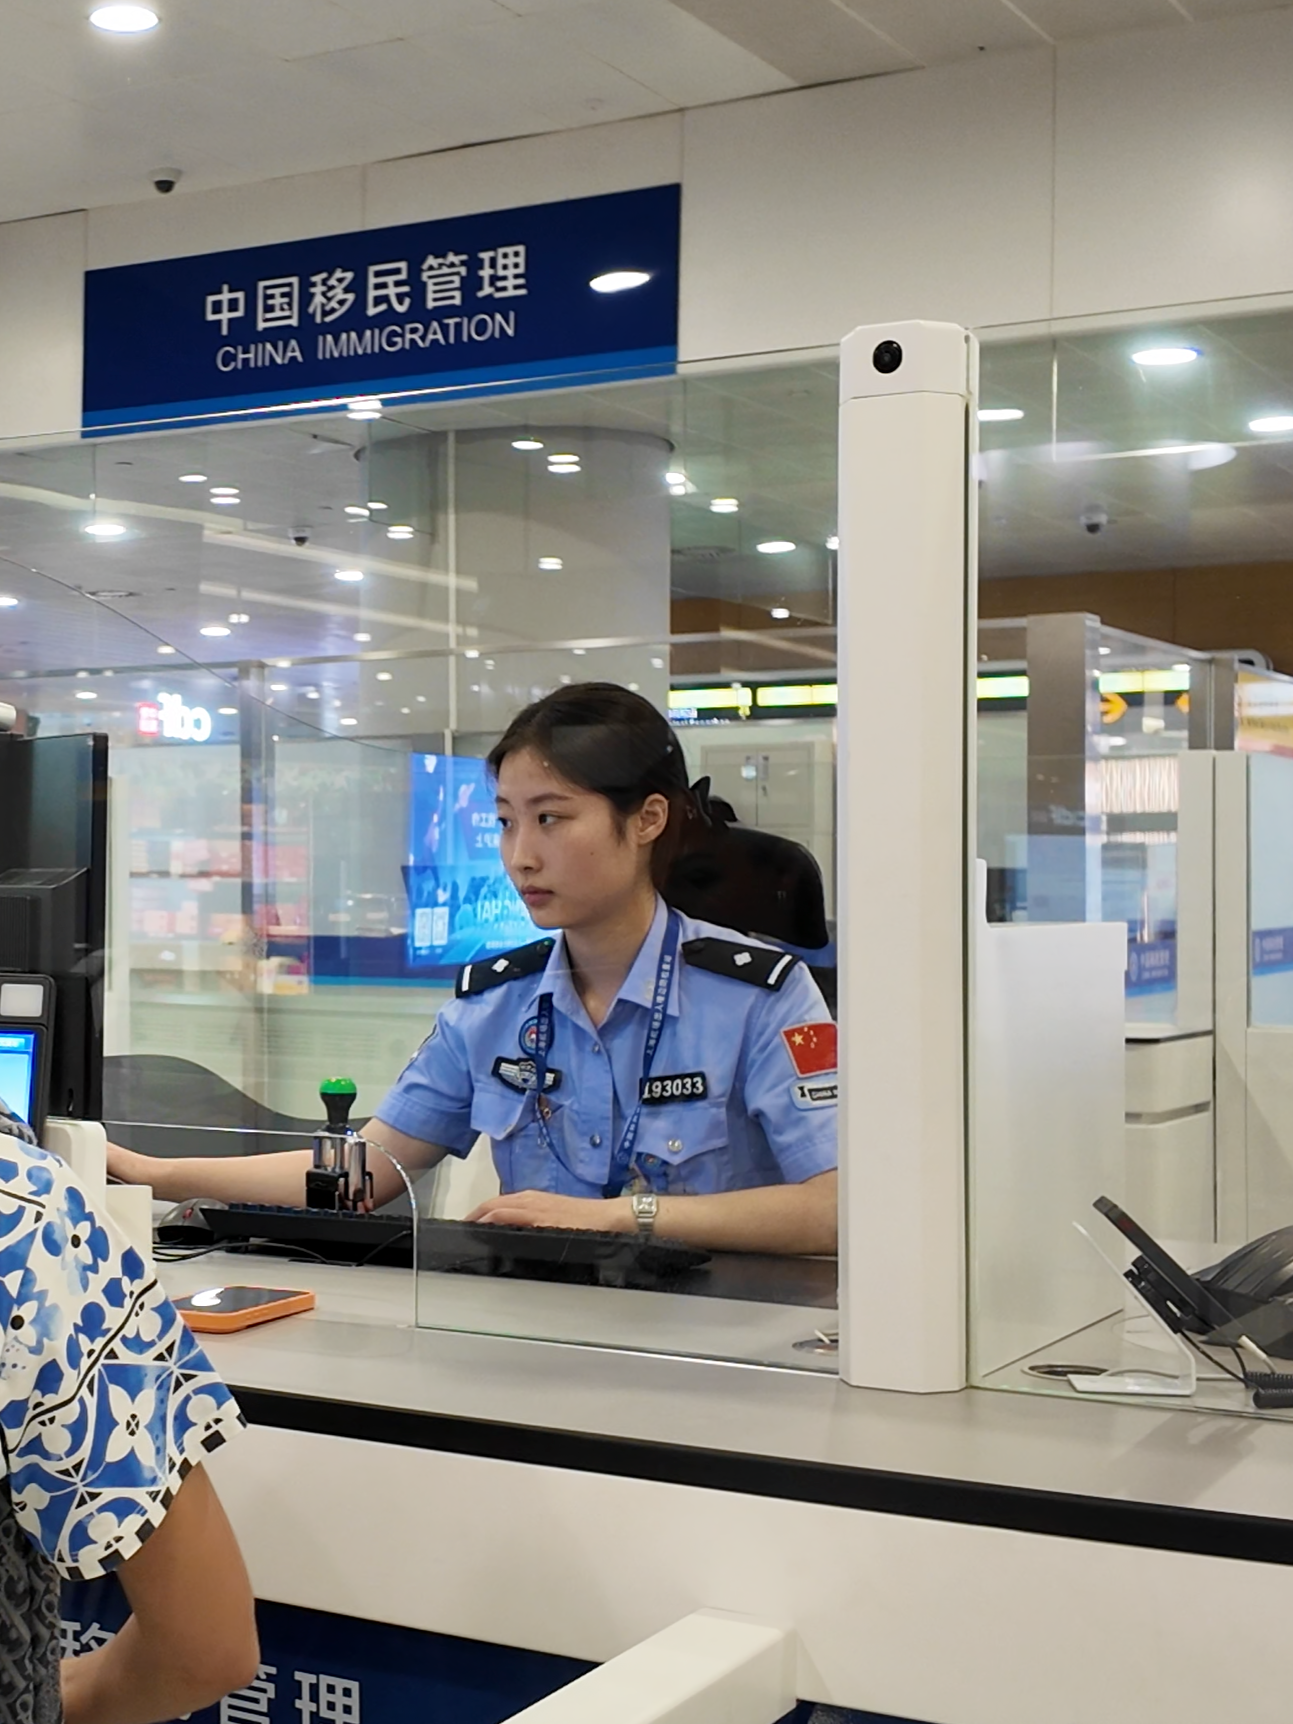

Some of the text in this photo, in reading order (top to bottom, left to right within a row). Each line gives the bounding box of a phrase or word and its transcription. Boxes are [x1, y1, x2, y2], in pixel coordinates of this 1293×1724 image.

[206, 245, 527, 337] 中国移民管理
[216, 311, 515, 373] CHINA IMMIGRATION
[642, 1077, 704, 1099] 193033
